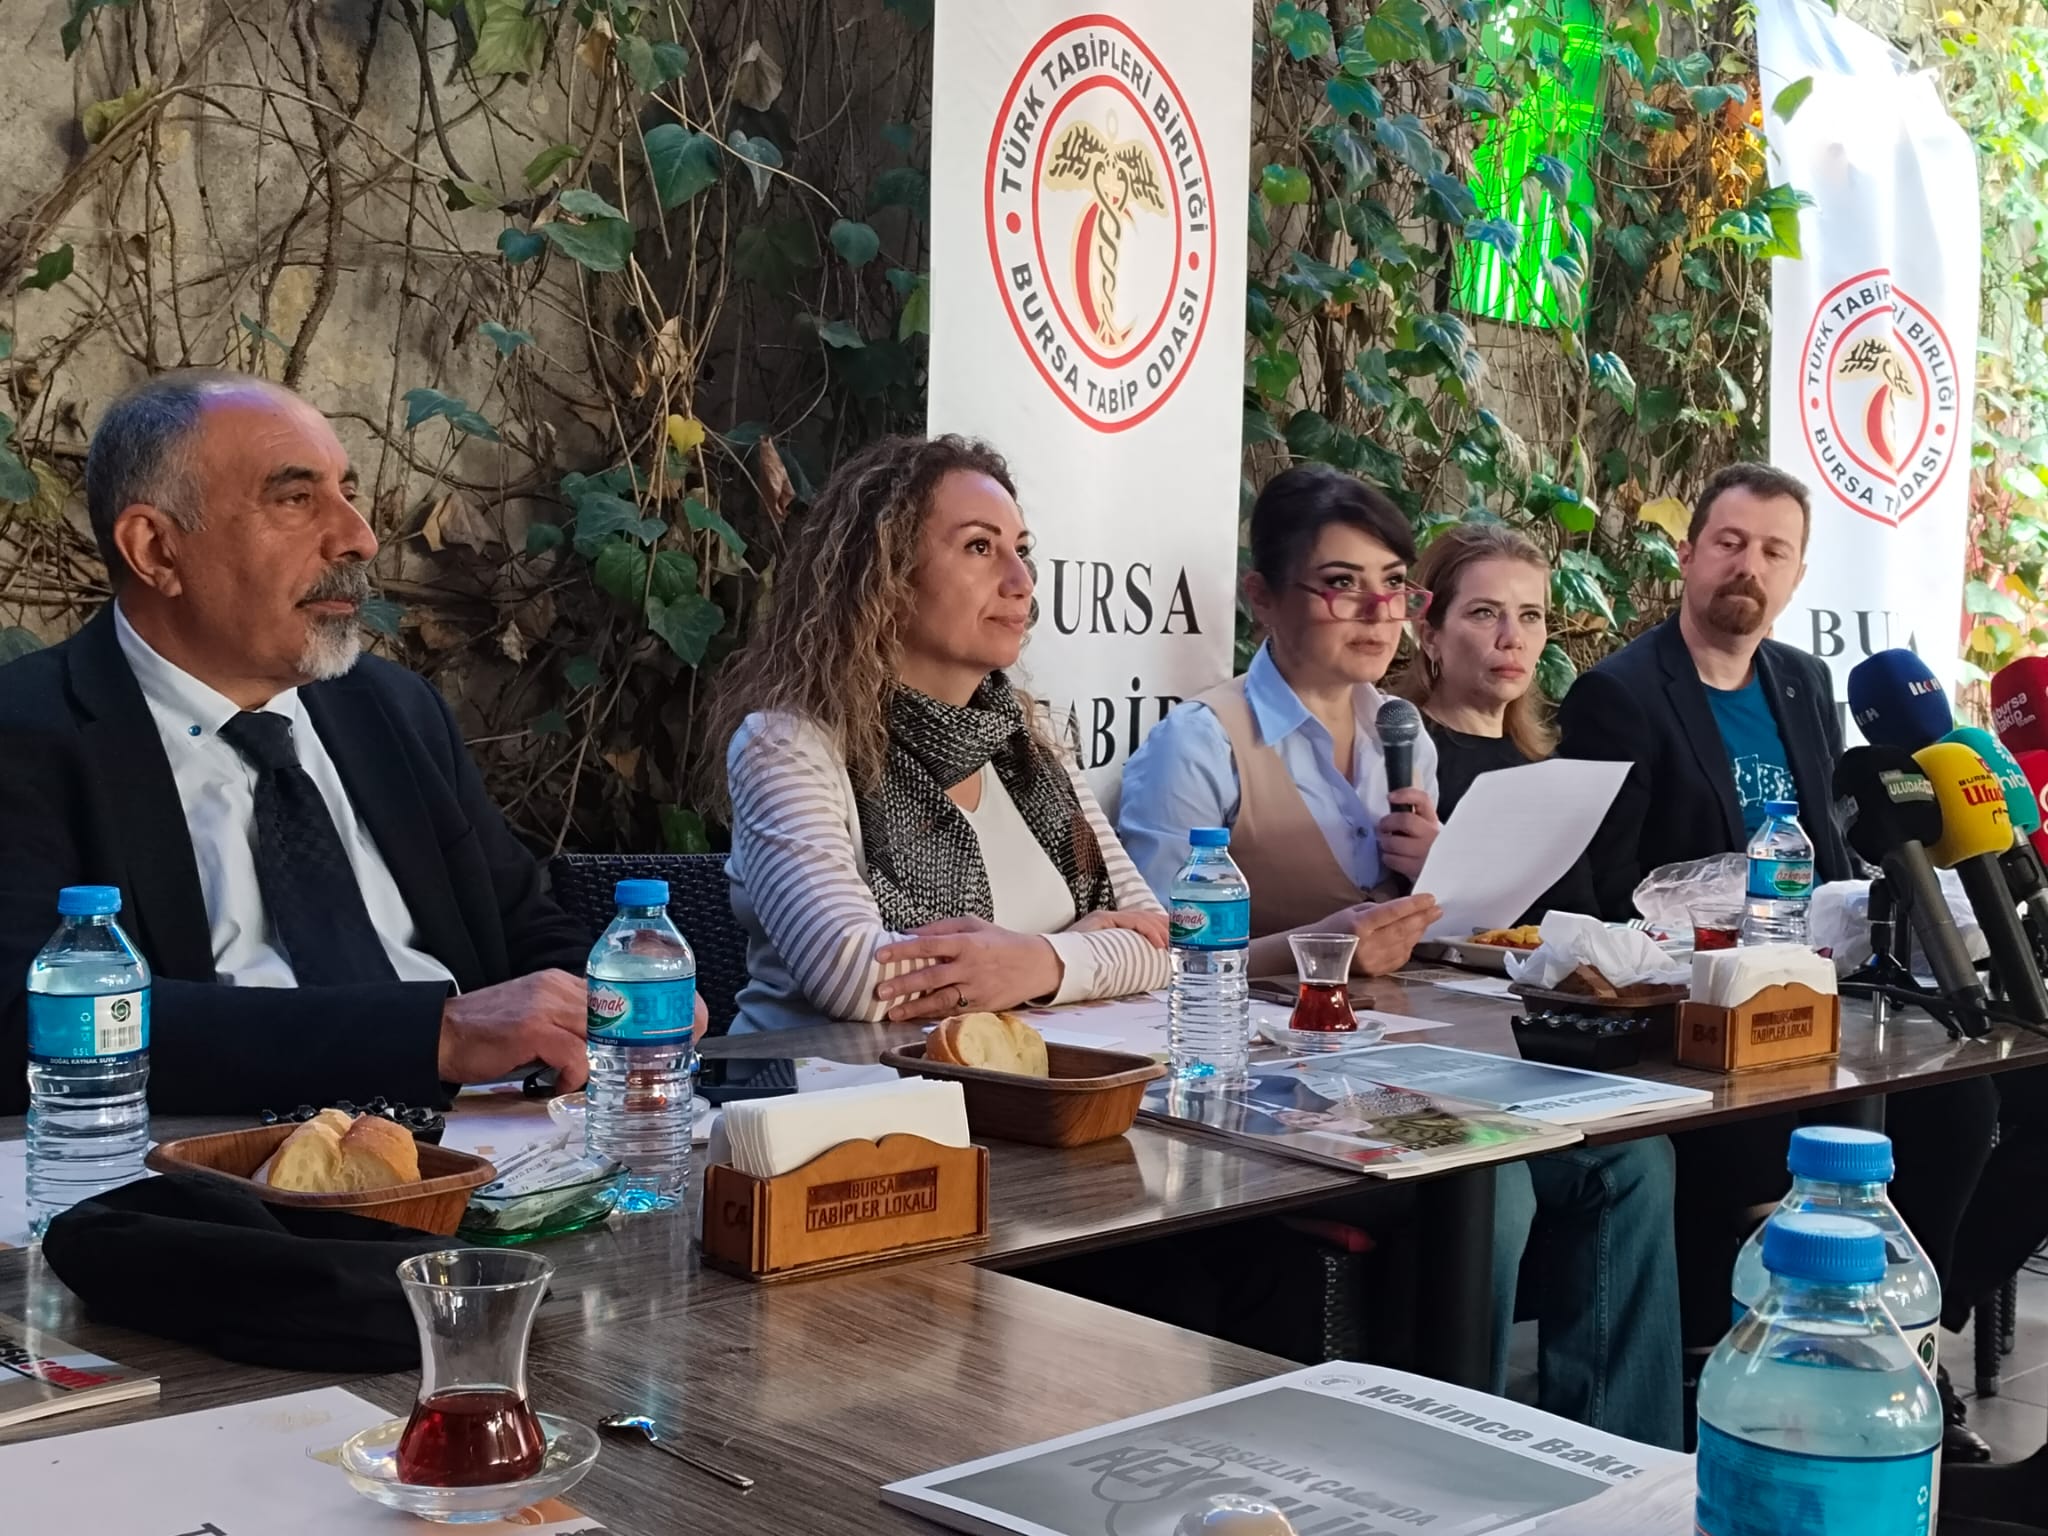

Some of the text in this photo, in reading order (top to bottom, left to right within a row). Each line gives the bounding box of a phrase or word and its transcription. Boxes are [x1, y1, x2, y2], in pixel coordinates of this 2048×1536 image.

[1001, 33, 1208, 233] TÜRK TABİPLERİ BİRLİĞİ
[1012, 262, 1198, 414] BURSA TABİP ODASI
[1808, 321, 1833, 386] TÜRK
[1908, 322, 1954, 411] BİRLİĞİ
[1815, 428, 1942, 504] BURSA DASI
[1027, 557, 1203, 635] URSA
[1036, 676, 1183, 770] ABİ
[723, 1200, 748, 1232] C4
[809, 1186, 933, 1229] TABİPLER LOKALİ
[852, 1177, 896, 1200] BURSA
[1354, 1384, 1534, 1443] Hekimce
